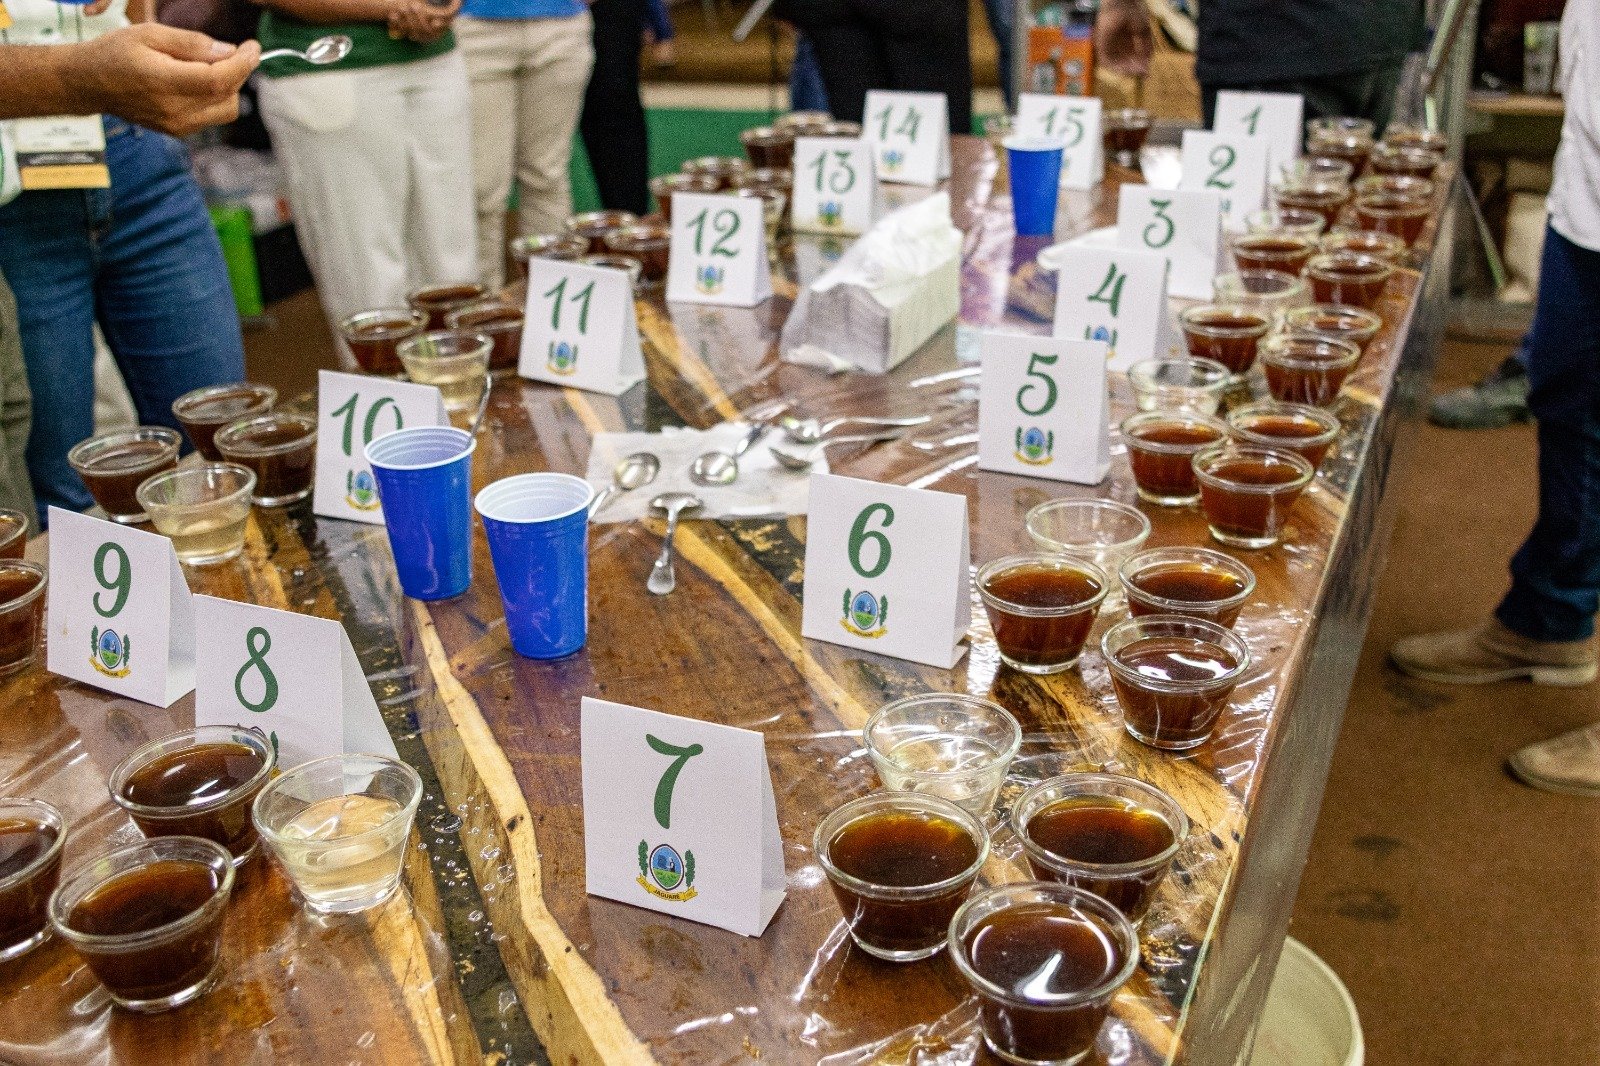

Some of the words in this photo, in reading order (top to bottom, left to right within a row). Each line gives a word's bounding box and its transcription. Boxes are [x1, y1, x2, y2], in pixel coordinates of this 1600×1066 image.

[875, 105, 921, 144] 14
[1040, 106, 1085, 148] 15
[1242, 106, 1263, 136] 1
[809, 150, 856, 194] 13
[1206, 145, 1236, 189] 2
[686, 207, 741, 257] 12
[1142, 197, 1175, 249] 3
[544, 277, 595, 333] 11
[1087, 263, 1126, 318] 4
[1015, 353, 1058, 416] 5
[332, 392, 404, 456] 10
[847, 503, 895, 579] 6
[93, 541, 132, 618] 9
[235, 627, 279, 713] 8
[646, 734, 704, 829] 7
